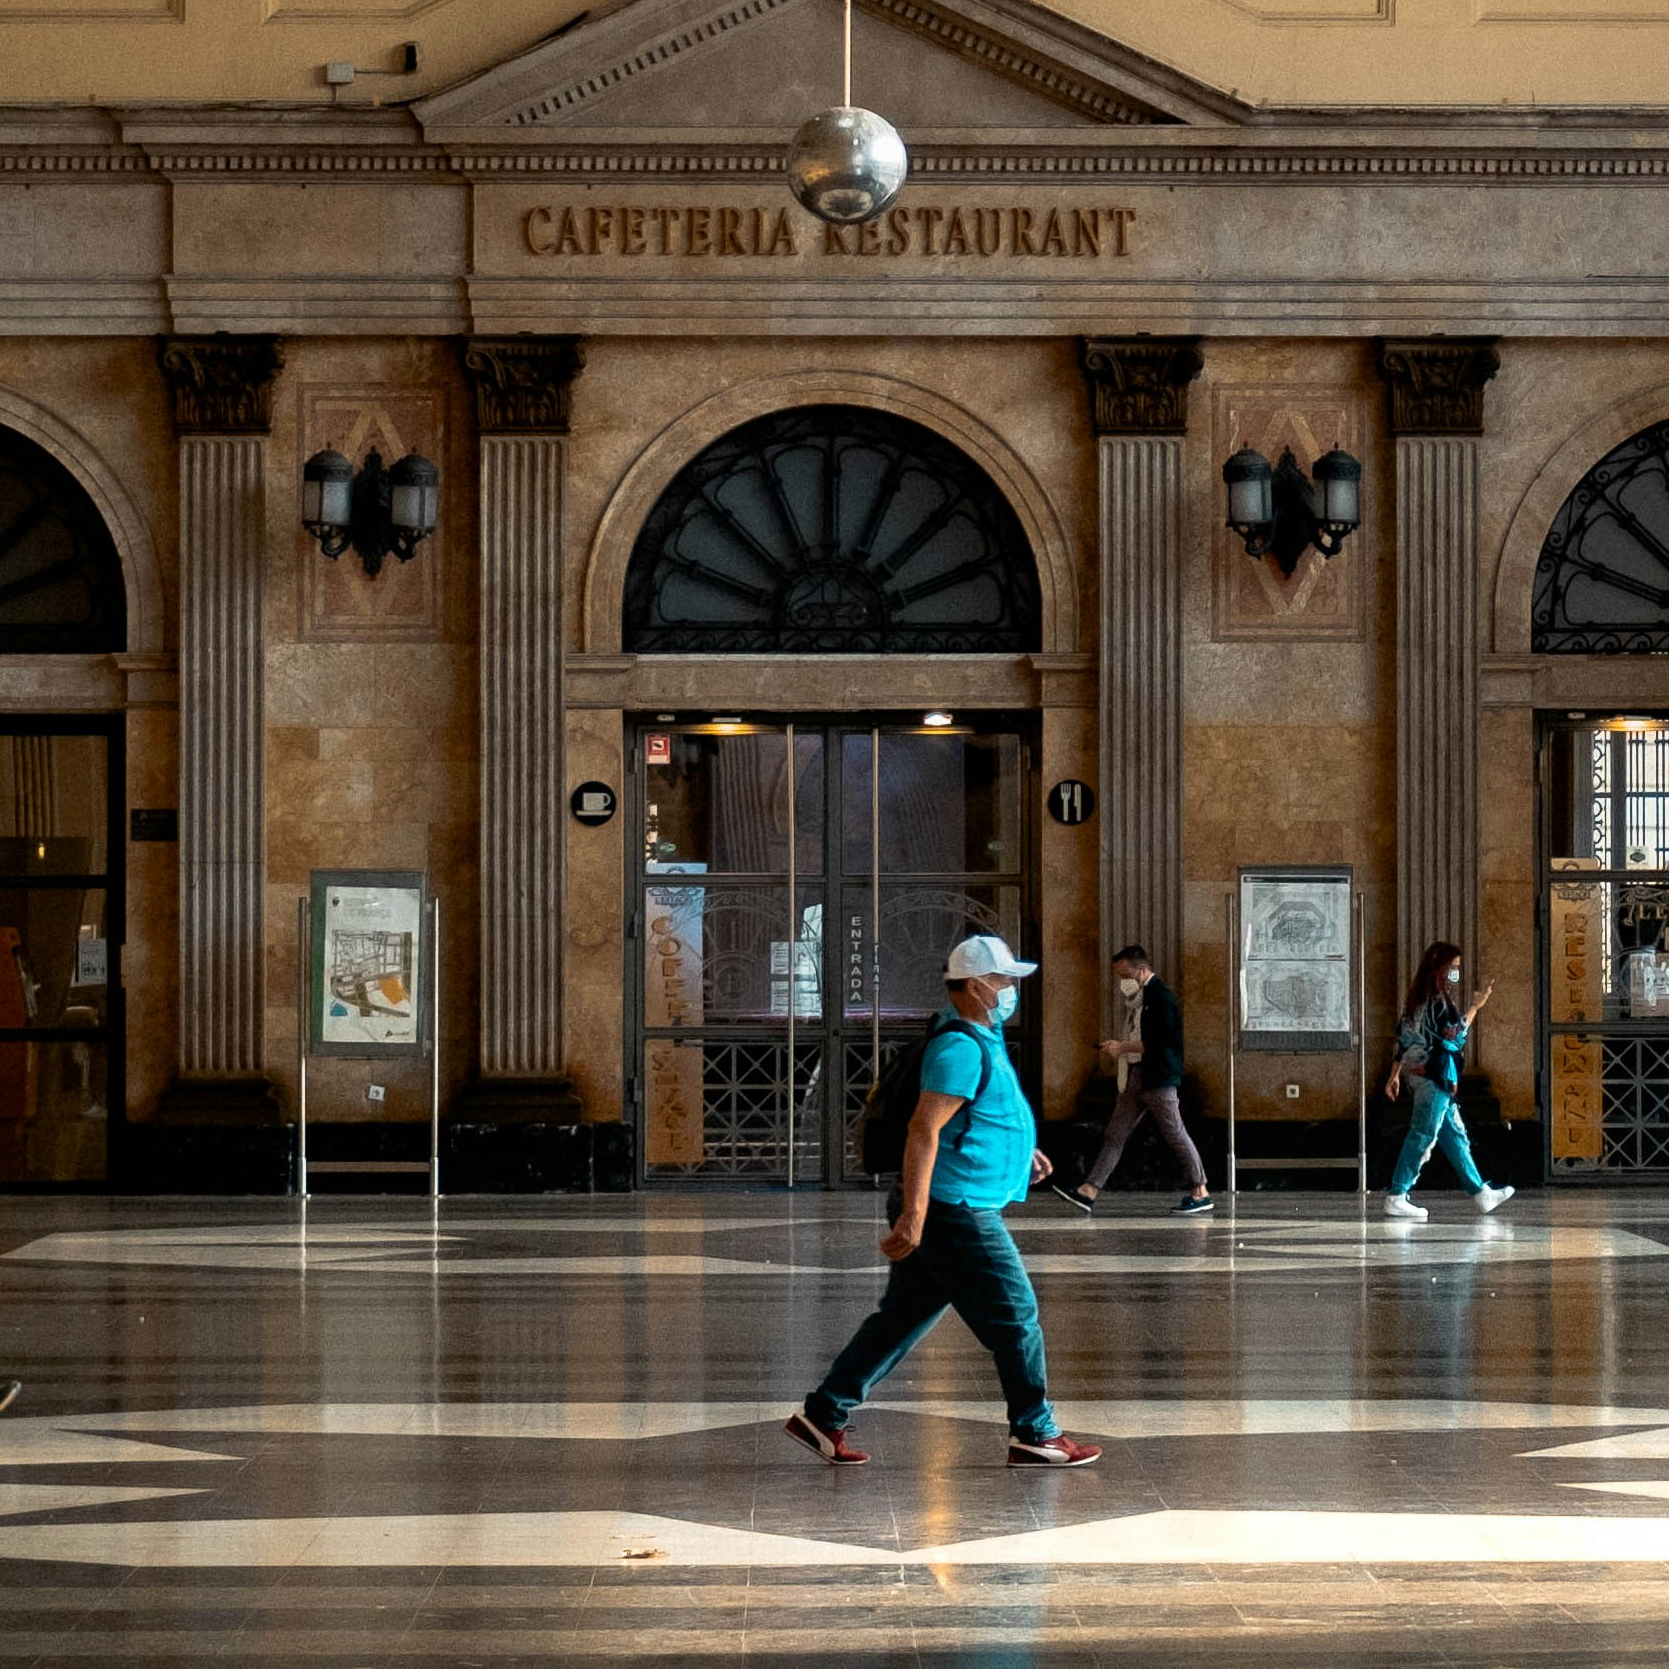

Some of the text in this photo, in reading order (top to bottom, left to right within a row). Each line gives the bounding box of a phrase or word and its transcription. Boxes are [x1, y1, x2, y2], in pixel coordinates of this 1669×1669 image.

[523, 205, 1138, 257] CAFETERIA RESTAURANT
[851, 916, 863, 1001] ENTRADA
